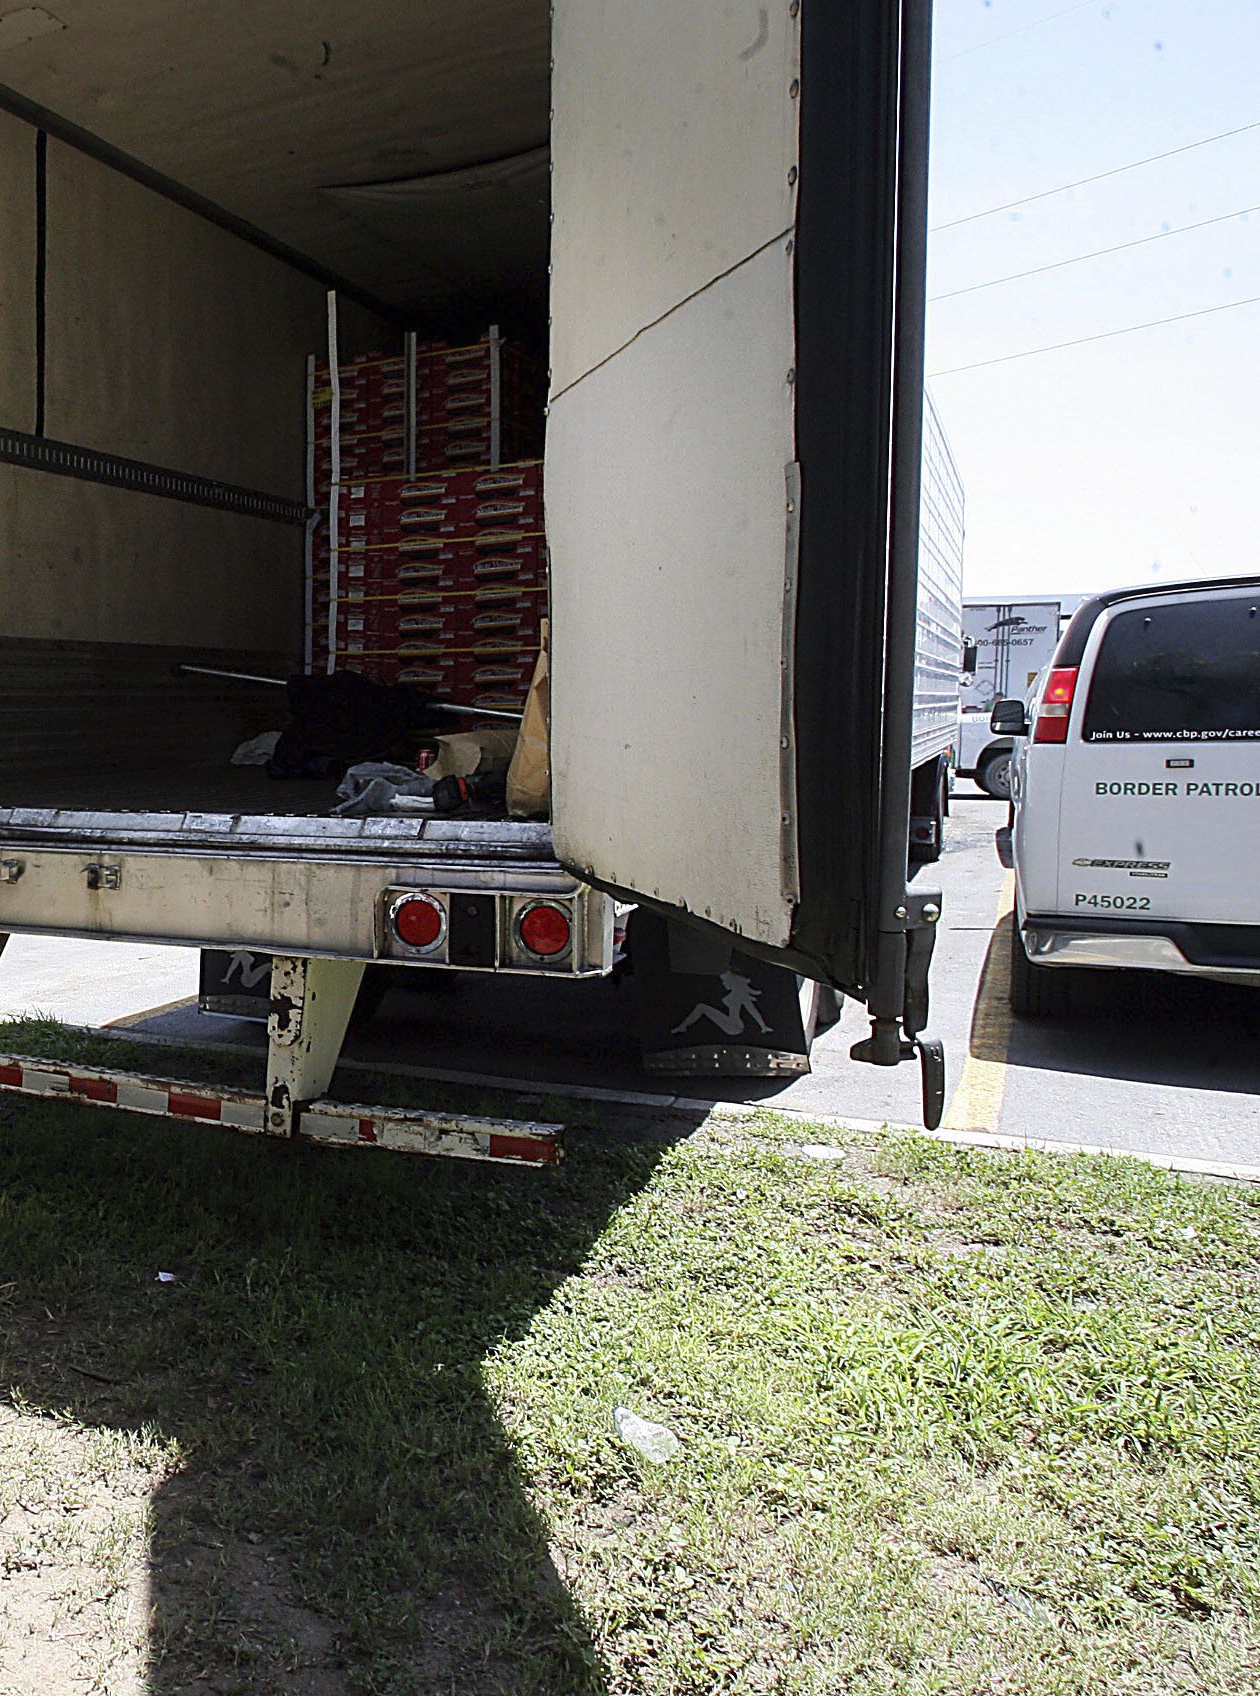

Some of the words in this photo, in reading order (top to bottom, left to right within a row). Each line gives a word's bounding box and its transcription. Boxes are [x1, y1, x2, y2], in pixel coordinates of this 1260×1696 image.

[1011, 625, 1047, 633] Panther
[1090, 730, 1113, 741] Join
[1116, 730, 1131, 739] Us
[1095, 782, 1178, 796] BORDER
[1092, 859, 1171, 870] EXPRESS
[1075, 893, 1151, 911] P45022
